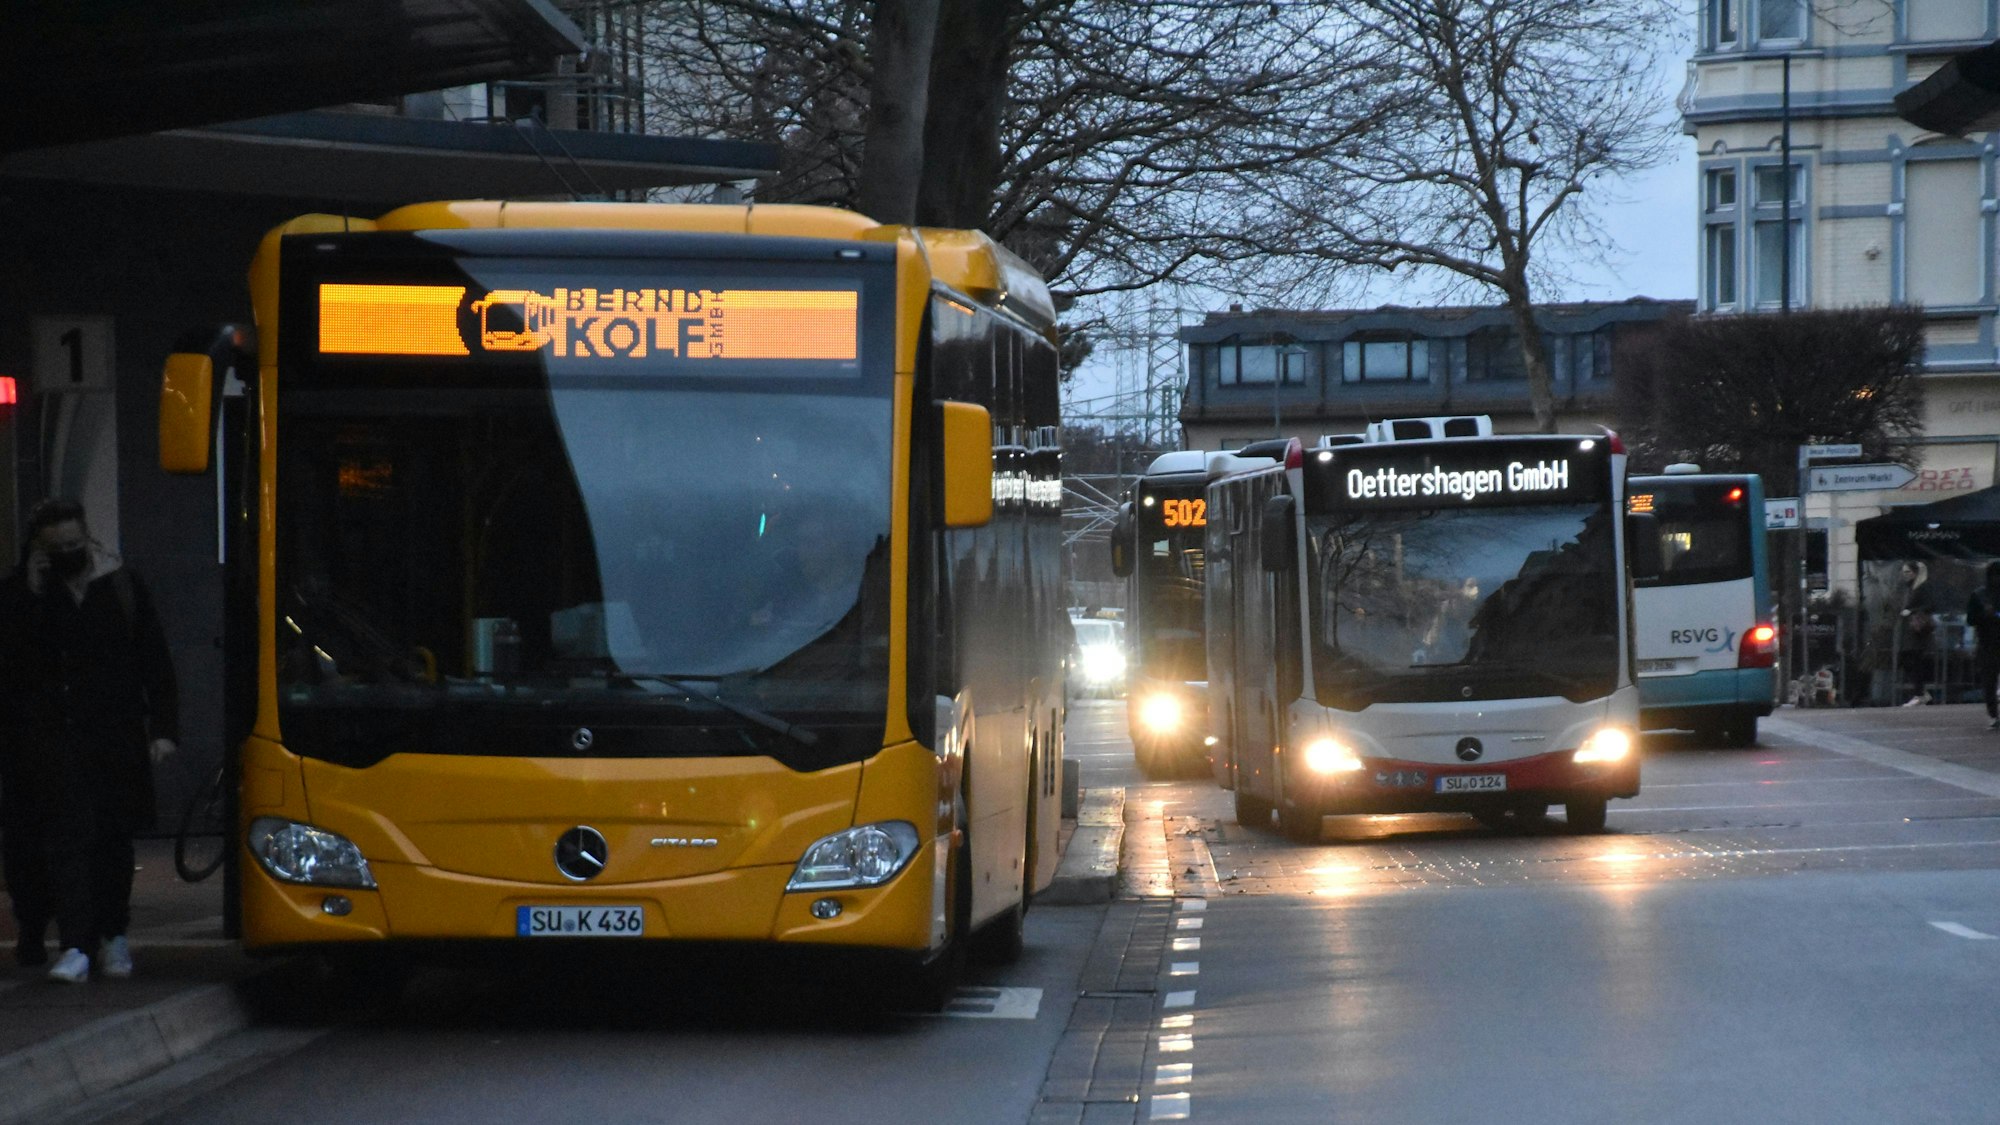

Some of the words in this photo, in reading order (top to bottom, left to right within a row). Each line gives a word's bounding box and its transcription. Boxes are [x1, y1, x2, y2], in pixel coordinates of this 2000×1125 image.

[567, 289, 701, 313] BERND
[566, 316, 704, 358] KOLF
[709, 289, 724, 358] GMBH
[61, 327, 82, 382] 1
[1348, 466, 1502, 500] Oettershagen
[1507, 459, 1568, 492] GmbH
[1164, 499, 1207, 527] 502
[1671, 628, 1719, 644] RSVG
[532, 910, 562, 932] SU
[577, 910, 593, 931] K
[598, 910, 641, 932] 436
